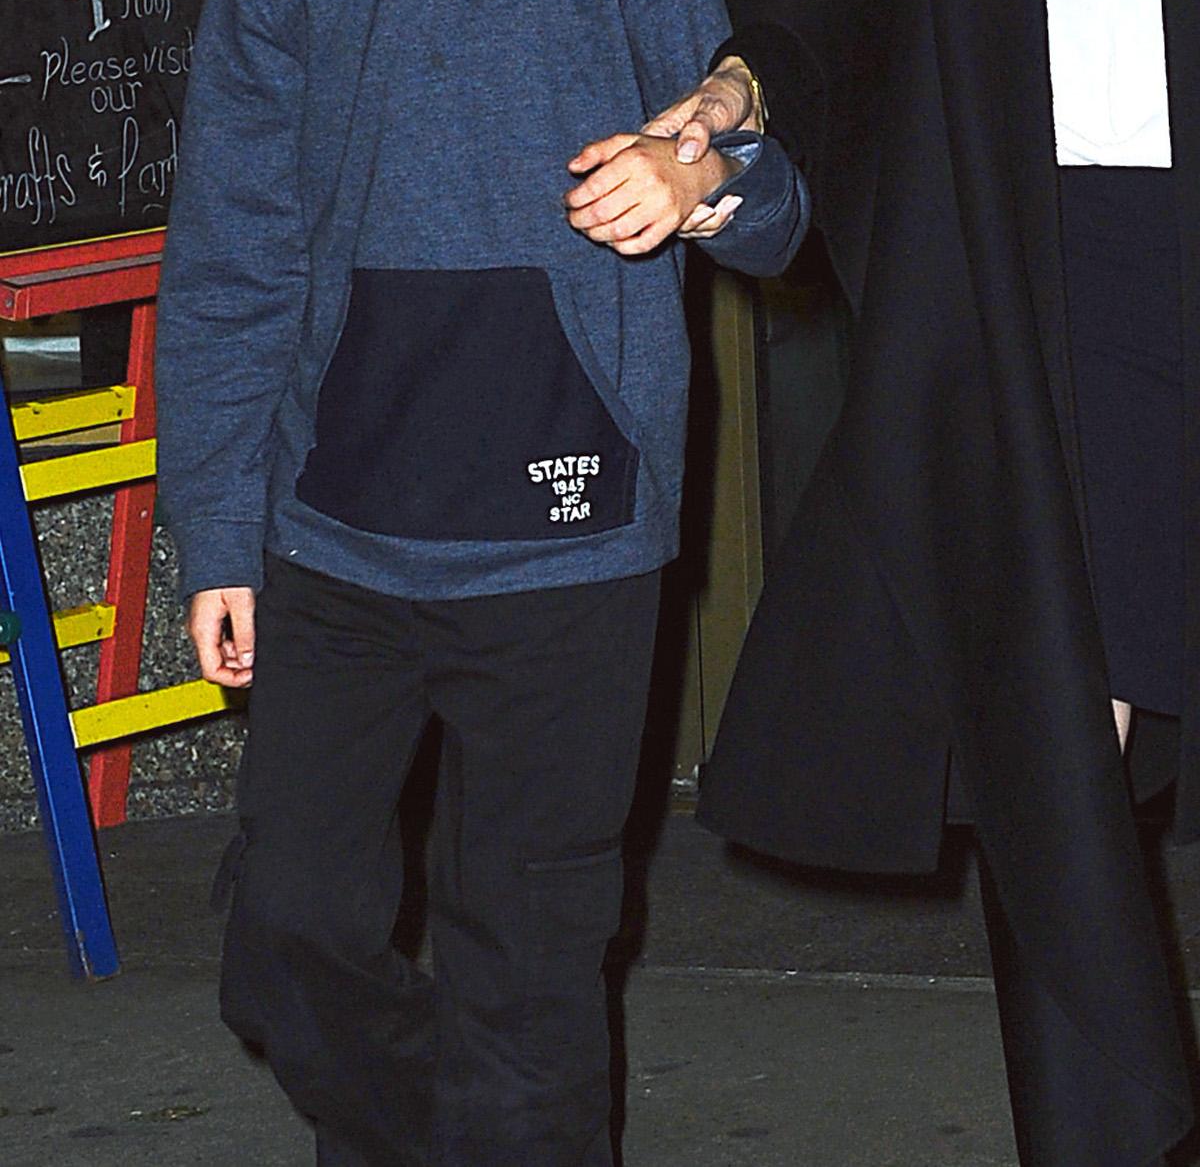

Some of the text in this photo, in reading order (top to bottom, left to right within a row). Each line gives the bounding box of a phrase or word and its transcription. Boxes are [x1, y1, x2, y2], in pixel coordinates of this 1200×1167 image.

[90, 81, 143, 113] our
[0, 126, 76, 225] rafts
[88, 143, 107, 187] &
[527, 454, 600, 483] STATES
[551, 477, 586, 495] 1945
[549, 501, 591, 522] STAR
[561, 493, 582, 507] NC
